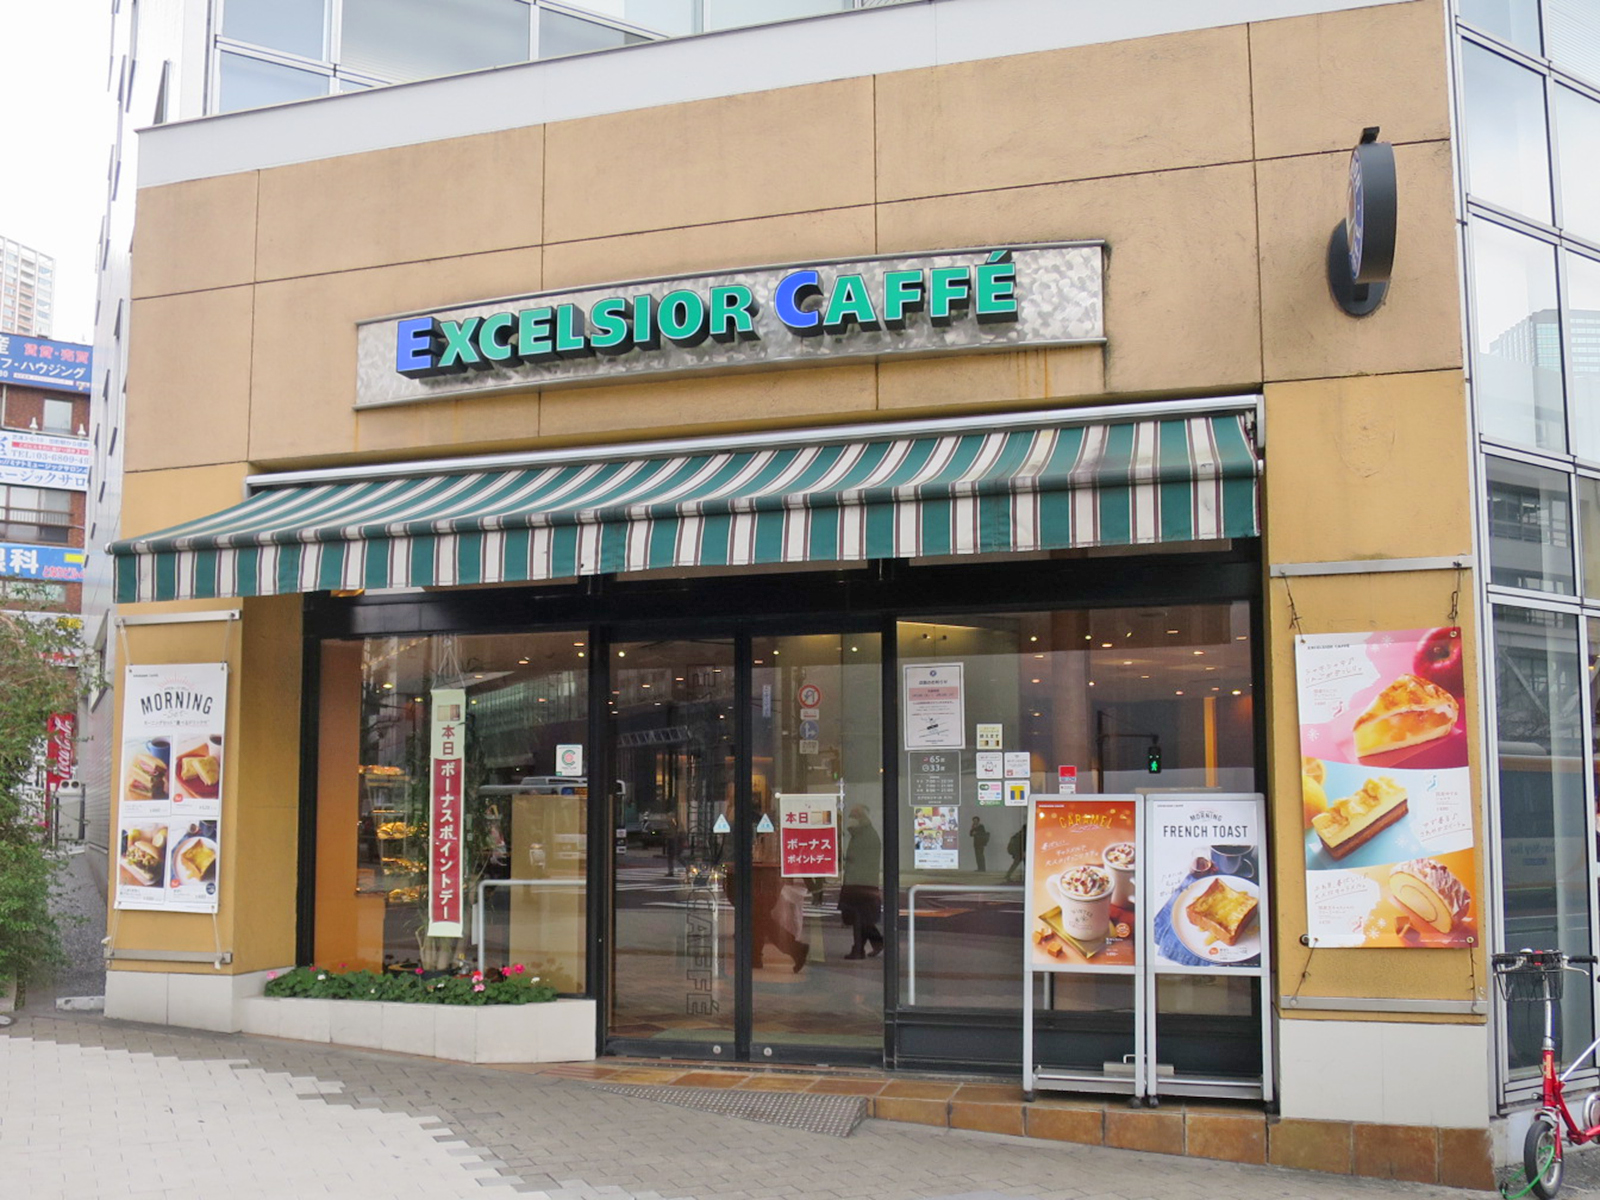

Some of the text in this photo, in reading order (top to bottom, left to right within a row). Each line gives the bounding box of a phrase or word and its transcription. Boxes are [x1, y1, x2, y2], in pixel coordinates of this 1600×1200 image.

[396, 250, 1018, 374] EXCELSIOR CAFFÉ
[140, 691, 213, 716] MORNING
[439, 724, 456, 920] 本日 ボーナスポイントデー
[785, 811, 809, 824] 本日
[1059, 814, 1113, 829] CARAMEL
[1163, 825, 1249, 838] FRENCH TOAST
[787, 838, 832, 850] ボーナス
[787, 854, 832, 864] ポイントデー
